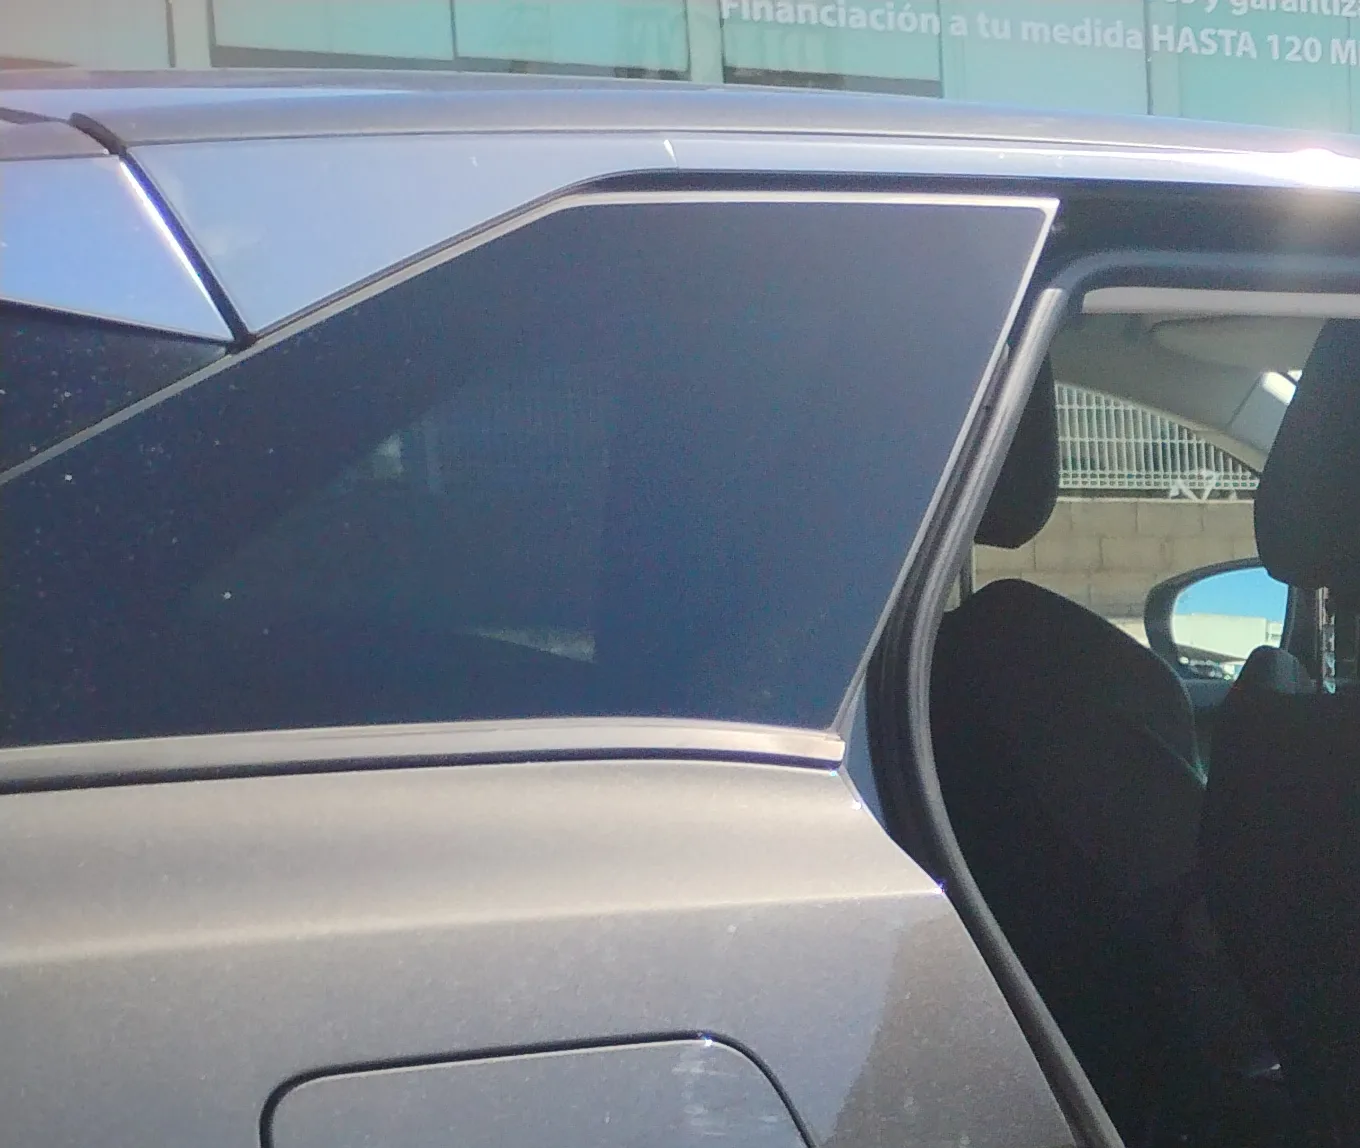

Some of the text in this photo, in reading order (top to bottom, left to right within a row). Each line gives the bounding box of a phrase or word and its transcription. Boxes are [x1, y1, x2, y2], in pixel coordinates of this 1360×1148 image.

[950, 15, 968, 36] a
[976, 14, 1012, 40] tu
[1021, 18, 1144, 50] medida
[1151, 24, 1258, 59] HASTA
[1266, 33, 1323, 64] 120
